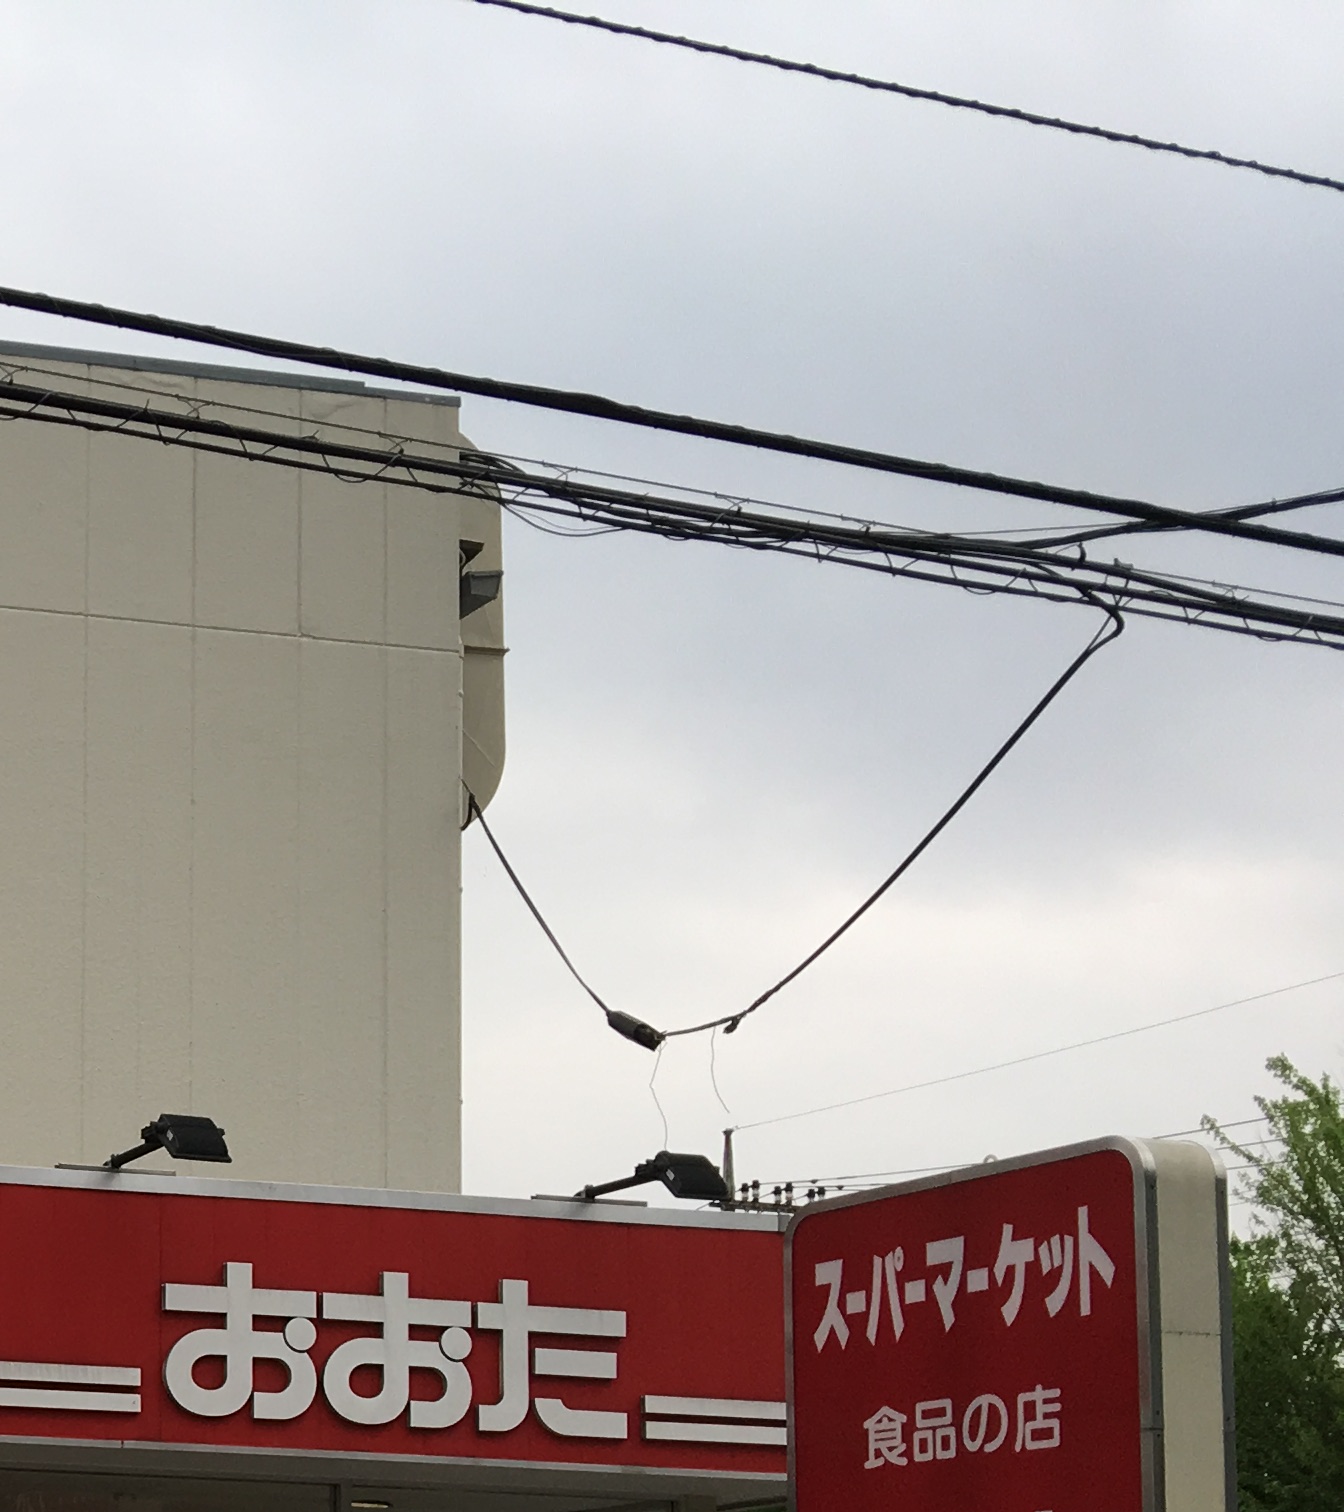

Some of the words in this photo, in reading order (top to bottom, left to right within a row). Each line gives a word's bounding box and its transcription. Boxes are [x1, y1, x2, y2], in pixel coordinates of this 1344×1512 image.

[162, 1261, 629, 1441] おおた
[813, 1205, 1116, 1353] スーパーマーケット
[863, 1384, 1062, 1469] 食品の店
